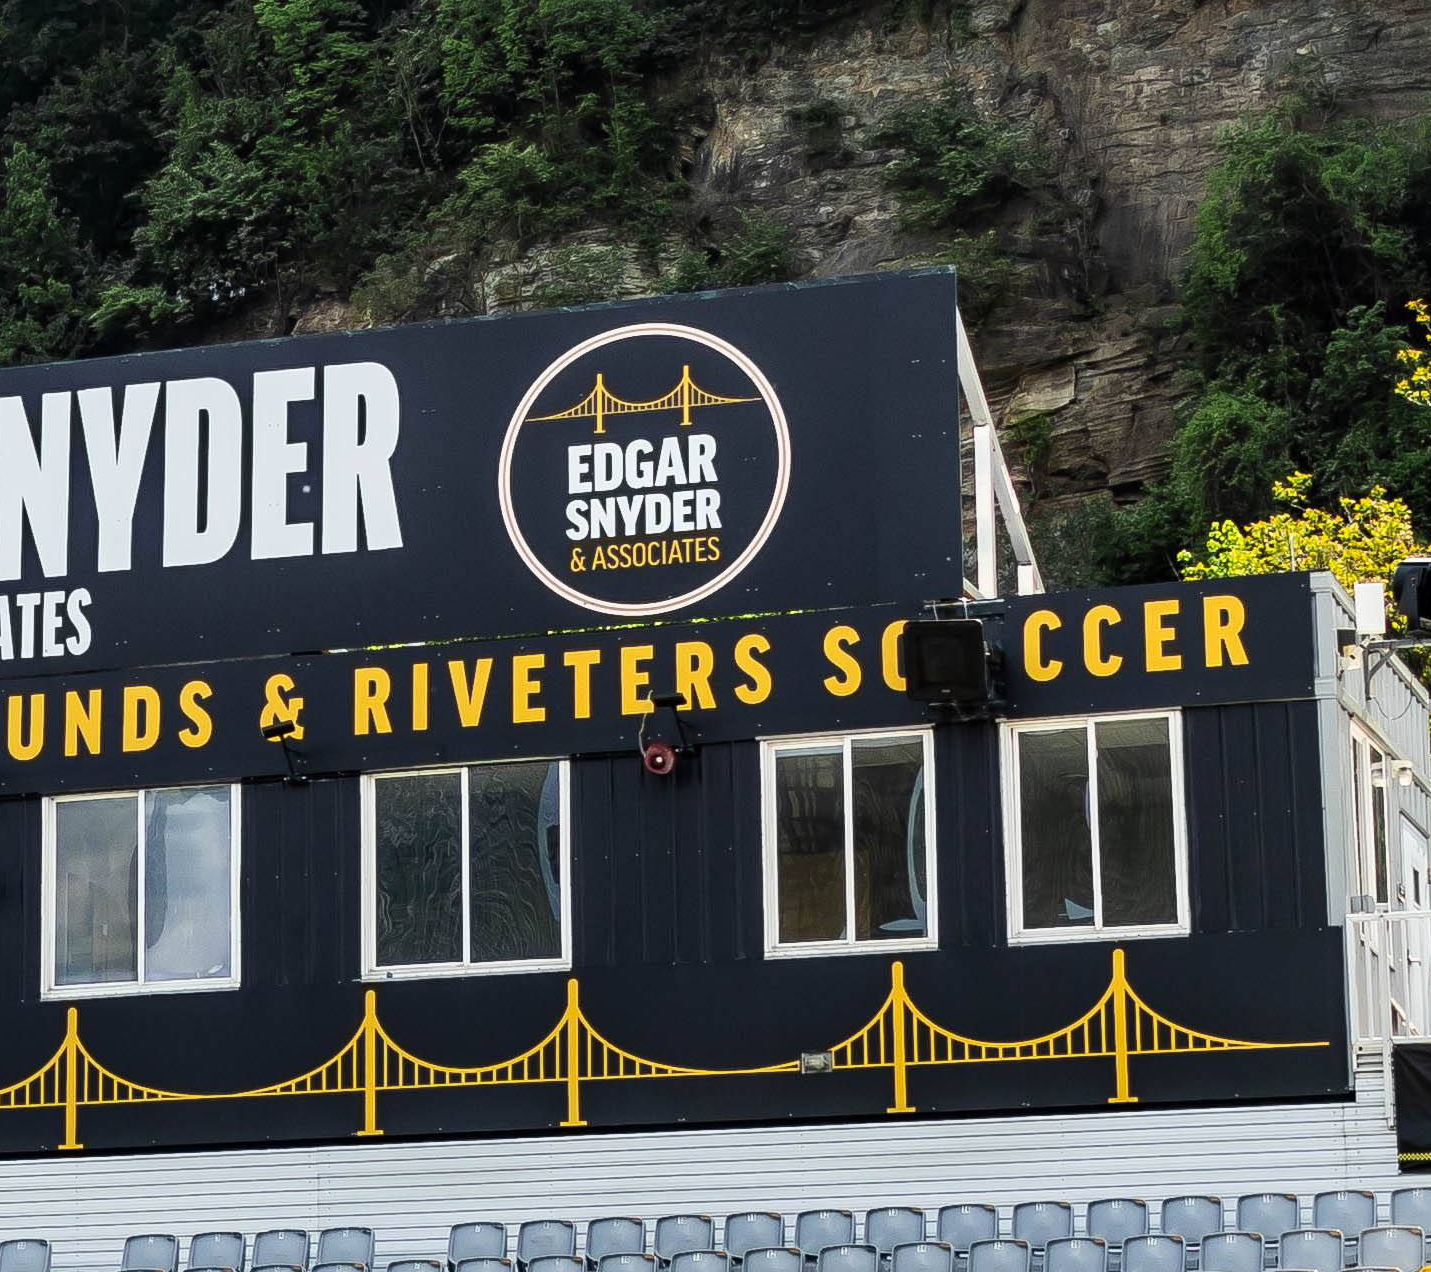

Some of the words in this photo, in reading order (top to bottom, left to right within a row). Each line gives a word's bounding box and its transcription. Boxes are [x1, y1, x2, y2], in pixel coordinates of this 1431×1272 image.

[568, 434, 718, 494] EDGAR
[566, 489, 722, 542] SNYDER
[570, 548, 587, 571] &
[591, 537, 720, 569] ASSOCIATES
[260, 674, 304, 741] &
[355, 633, 771, 735] RIVETERS
